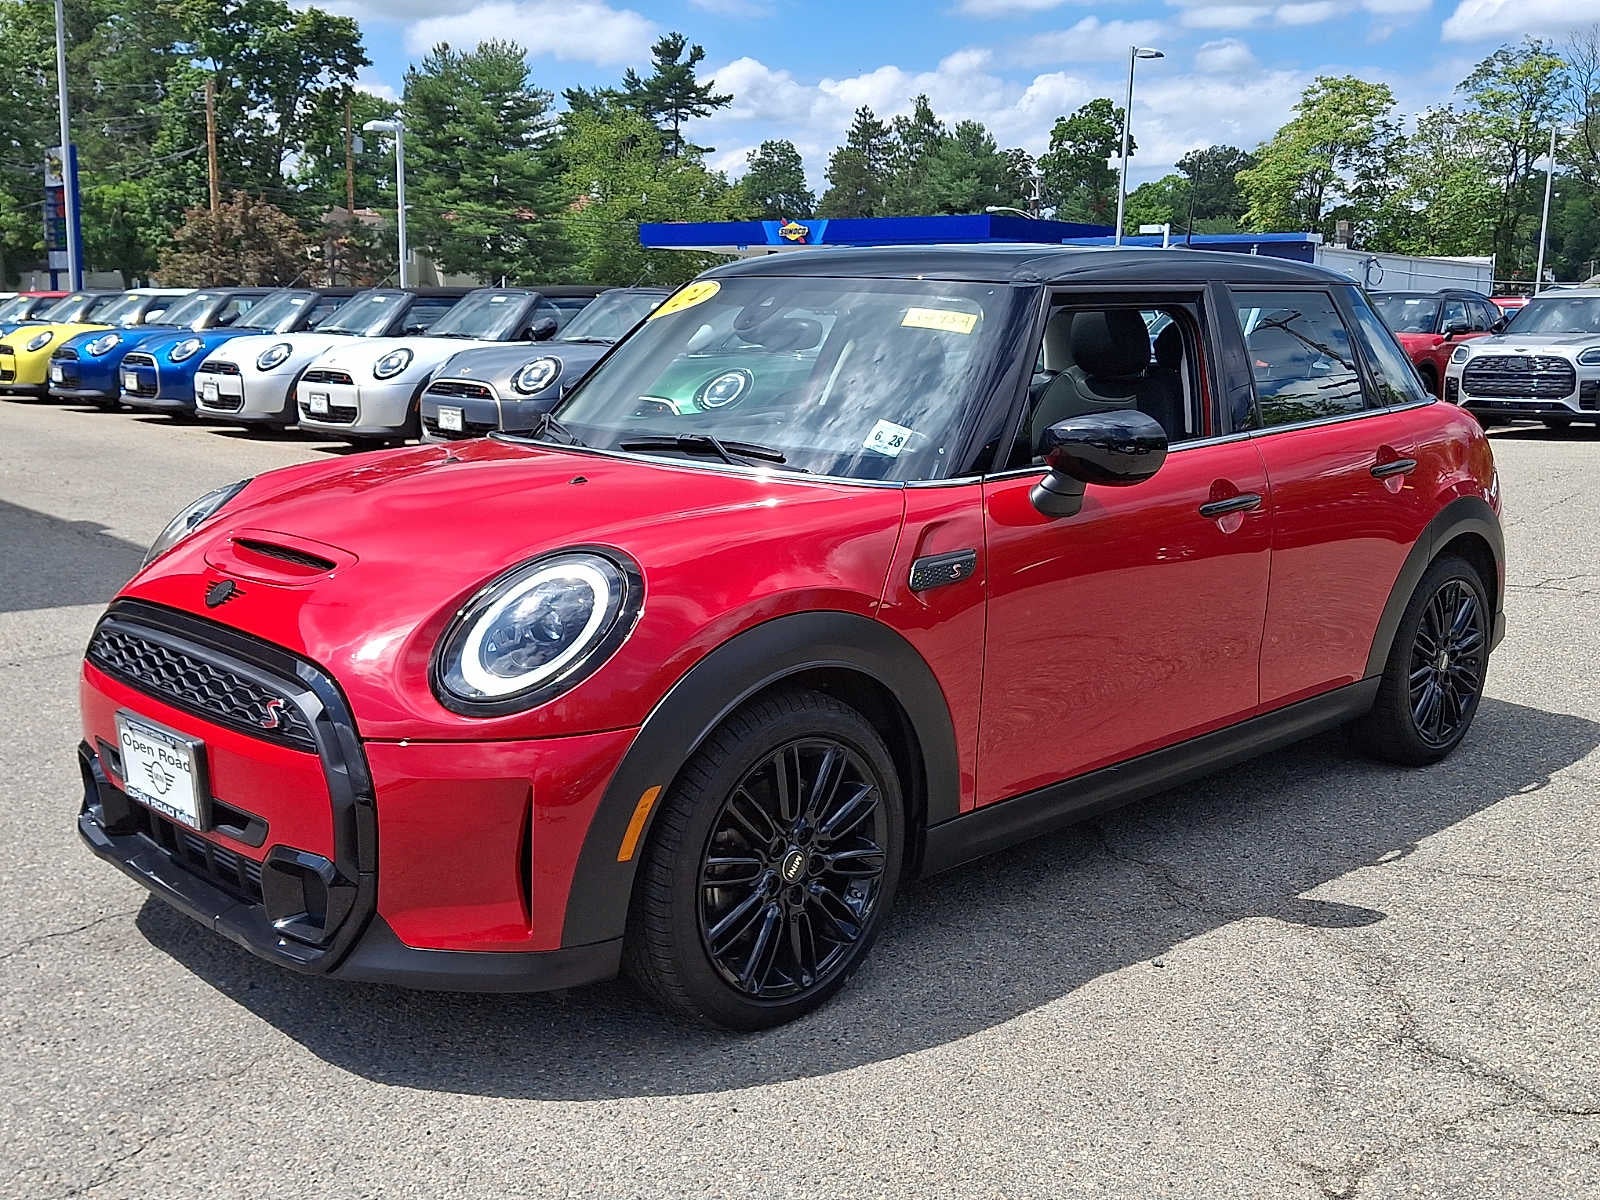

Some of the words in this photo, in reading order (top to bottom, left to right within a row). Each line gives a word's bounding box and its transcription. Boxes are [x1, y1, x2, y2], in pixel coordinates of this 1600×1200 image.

[780, 226, 808, 236] SUNOCO
[874, 430, 884, 441] 6
[888, 434, 904, 448] 28
[260, 699, 285, 729] S
[122, 732, 154, 758] Open
[158, 748, 191, 773] Road
[787, 855, 802, 878] MINI
